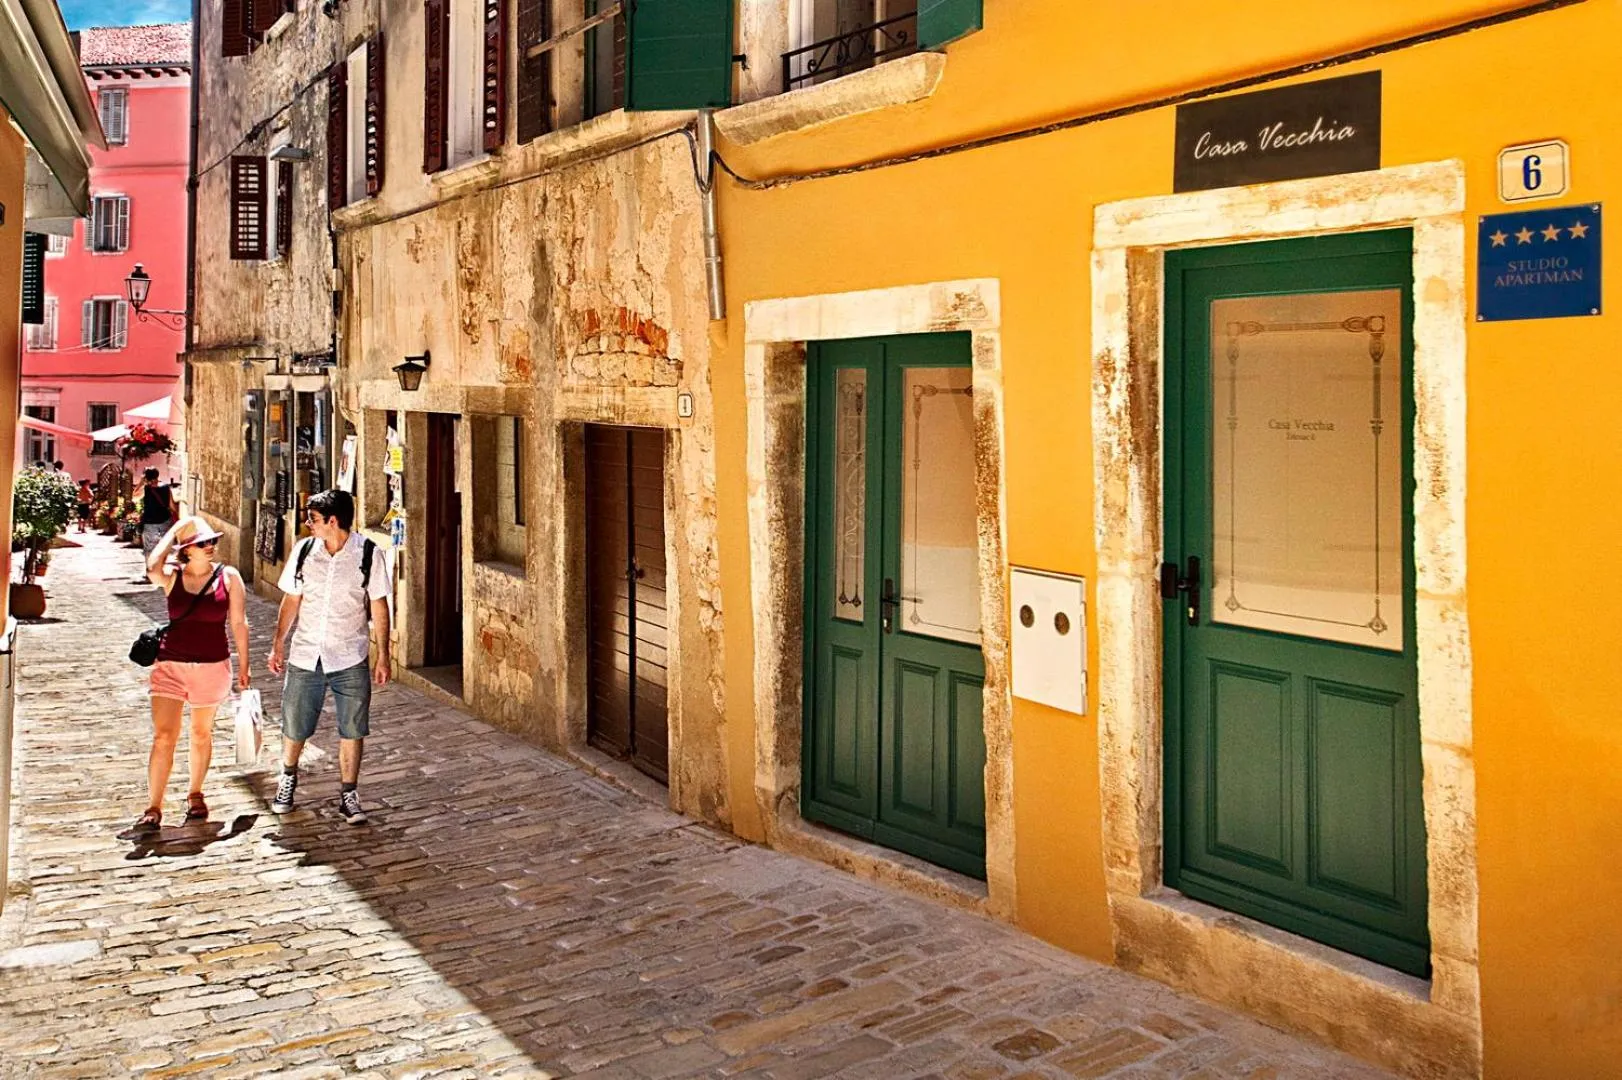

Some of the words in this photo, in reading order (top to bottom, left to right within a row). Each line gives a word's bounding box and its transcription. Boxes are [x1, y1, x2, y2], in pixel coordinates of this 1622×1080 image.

[1194, 131, 1249, 160] Casa
[1258, 116, 1356, 151] Vecchia
[1522, 154, 1542, 191] 6
[1494, 268, 1584, 287] APARTMAN
[1507, 256, 1569, 273] STUDIO
